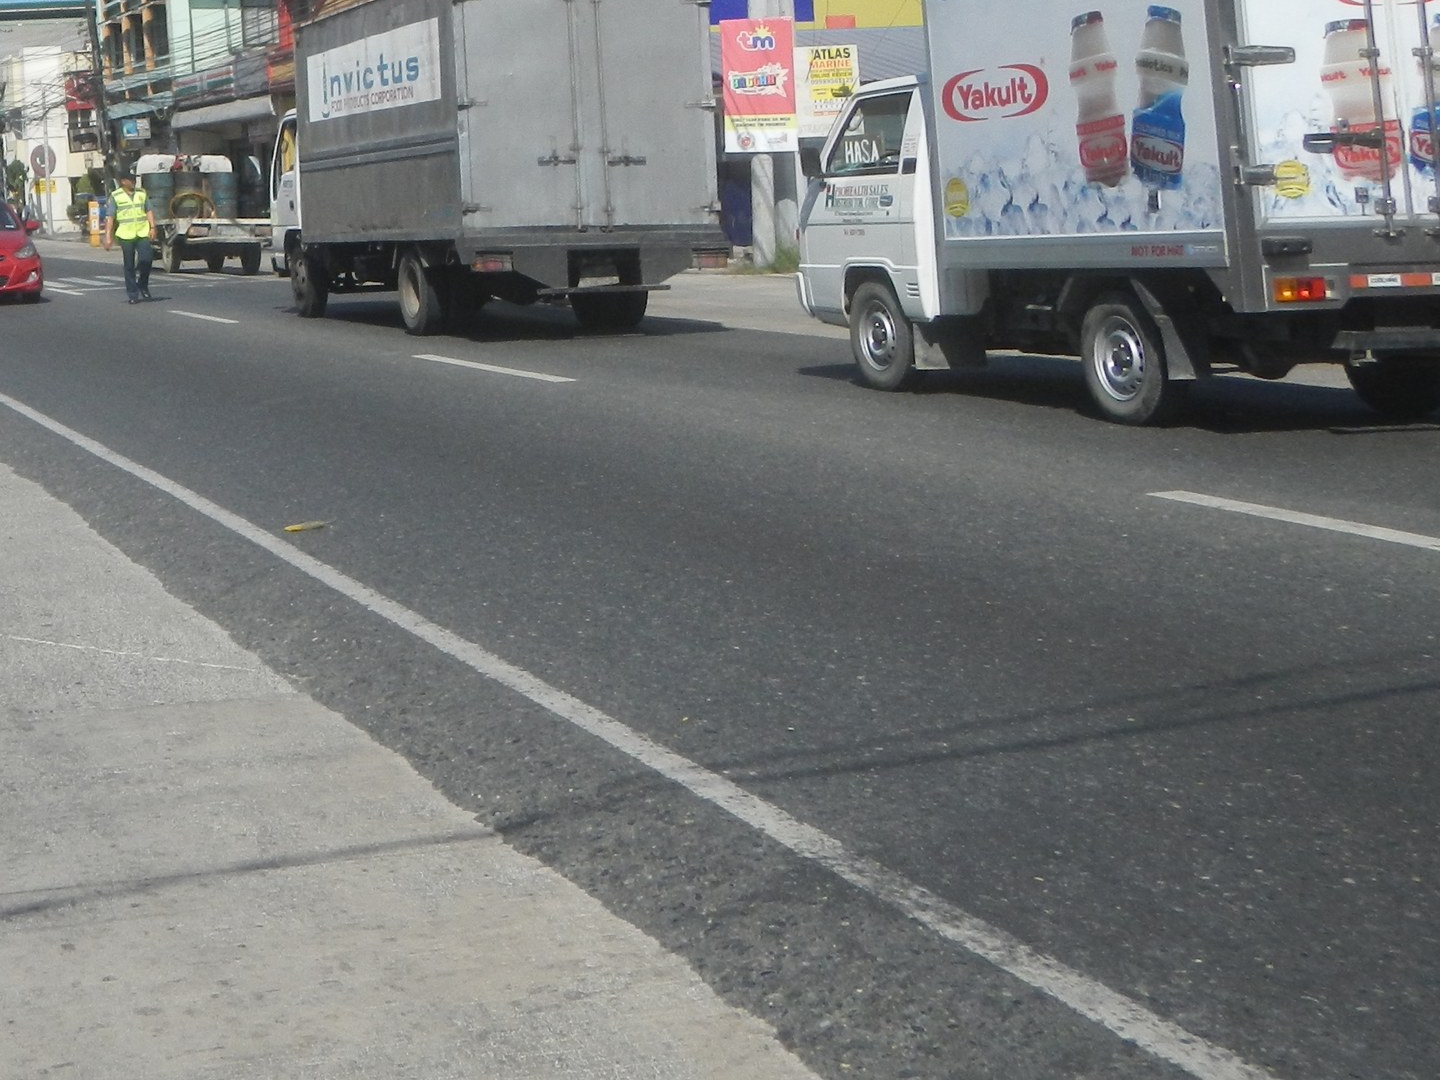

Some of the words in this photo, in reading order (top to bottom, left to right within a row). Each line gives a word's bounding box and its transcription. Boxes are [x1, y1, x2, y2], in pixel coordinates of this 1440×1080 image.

[737, 31, 776, 52] tm
[811, 59, 852, 69] MARINE
[813, 47, 851, 60] ATLAS
[370, 85, 415, 106] CORPORATION
[957, 77, 1033, 111] Yakult
[845, 139, 879, 164] HASA
[1131, 244, 1148, 256] NOT
